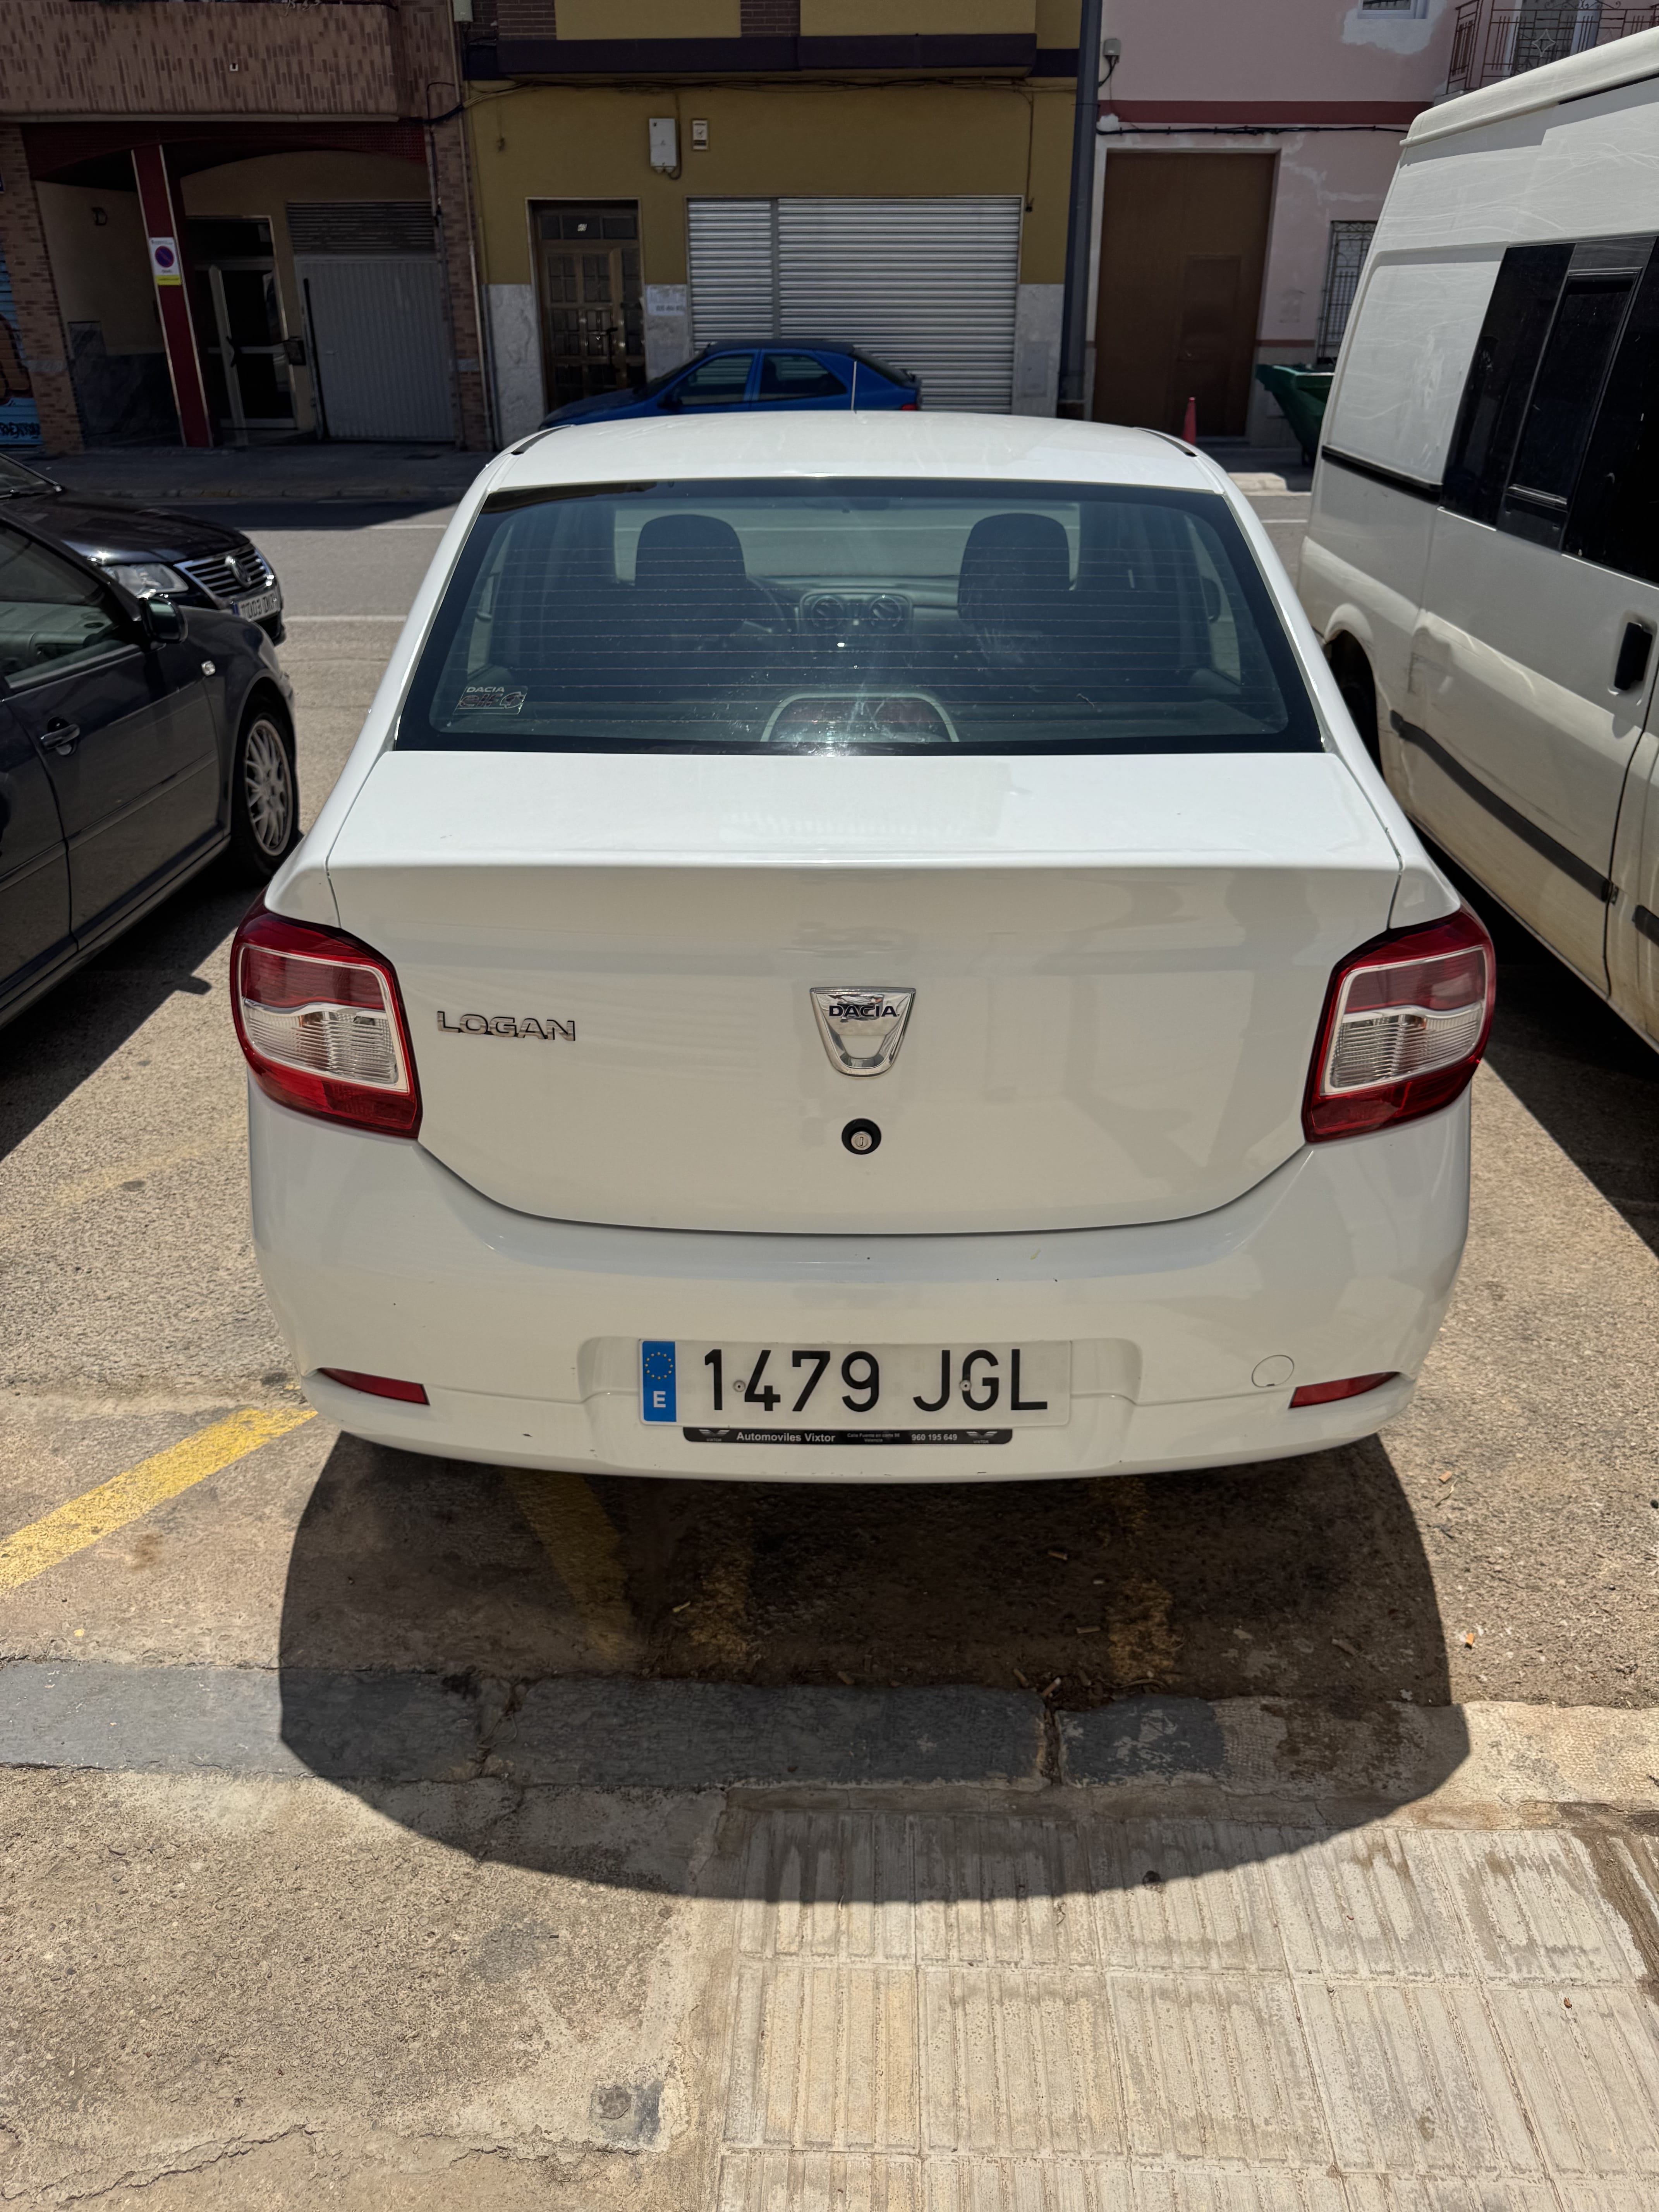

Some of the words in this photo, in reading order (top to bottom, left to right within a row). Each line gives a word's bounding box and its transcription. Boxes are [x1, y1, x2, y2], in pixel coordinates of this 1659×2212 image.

[829, 1005, 897, 1017] DACIA
[437, 1011, 576, 1041] LOGAN
[704, 1349, 879, 1412] 1479
[913, 1349, 1048, 1412] JGL
[653, 1391, 666, 1408] E
[737, 1432, 801, 1441] Automoviles
[804, 1433, 836, 1442] Vixtor
